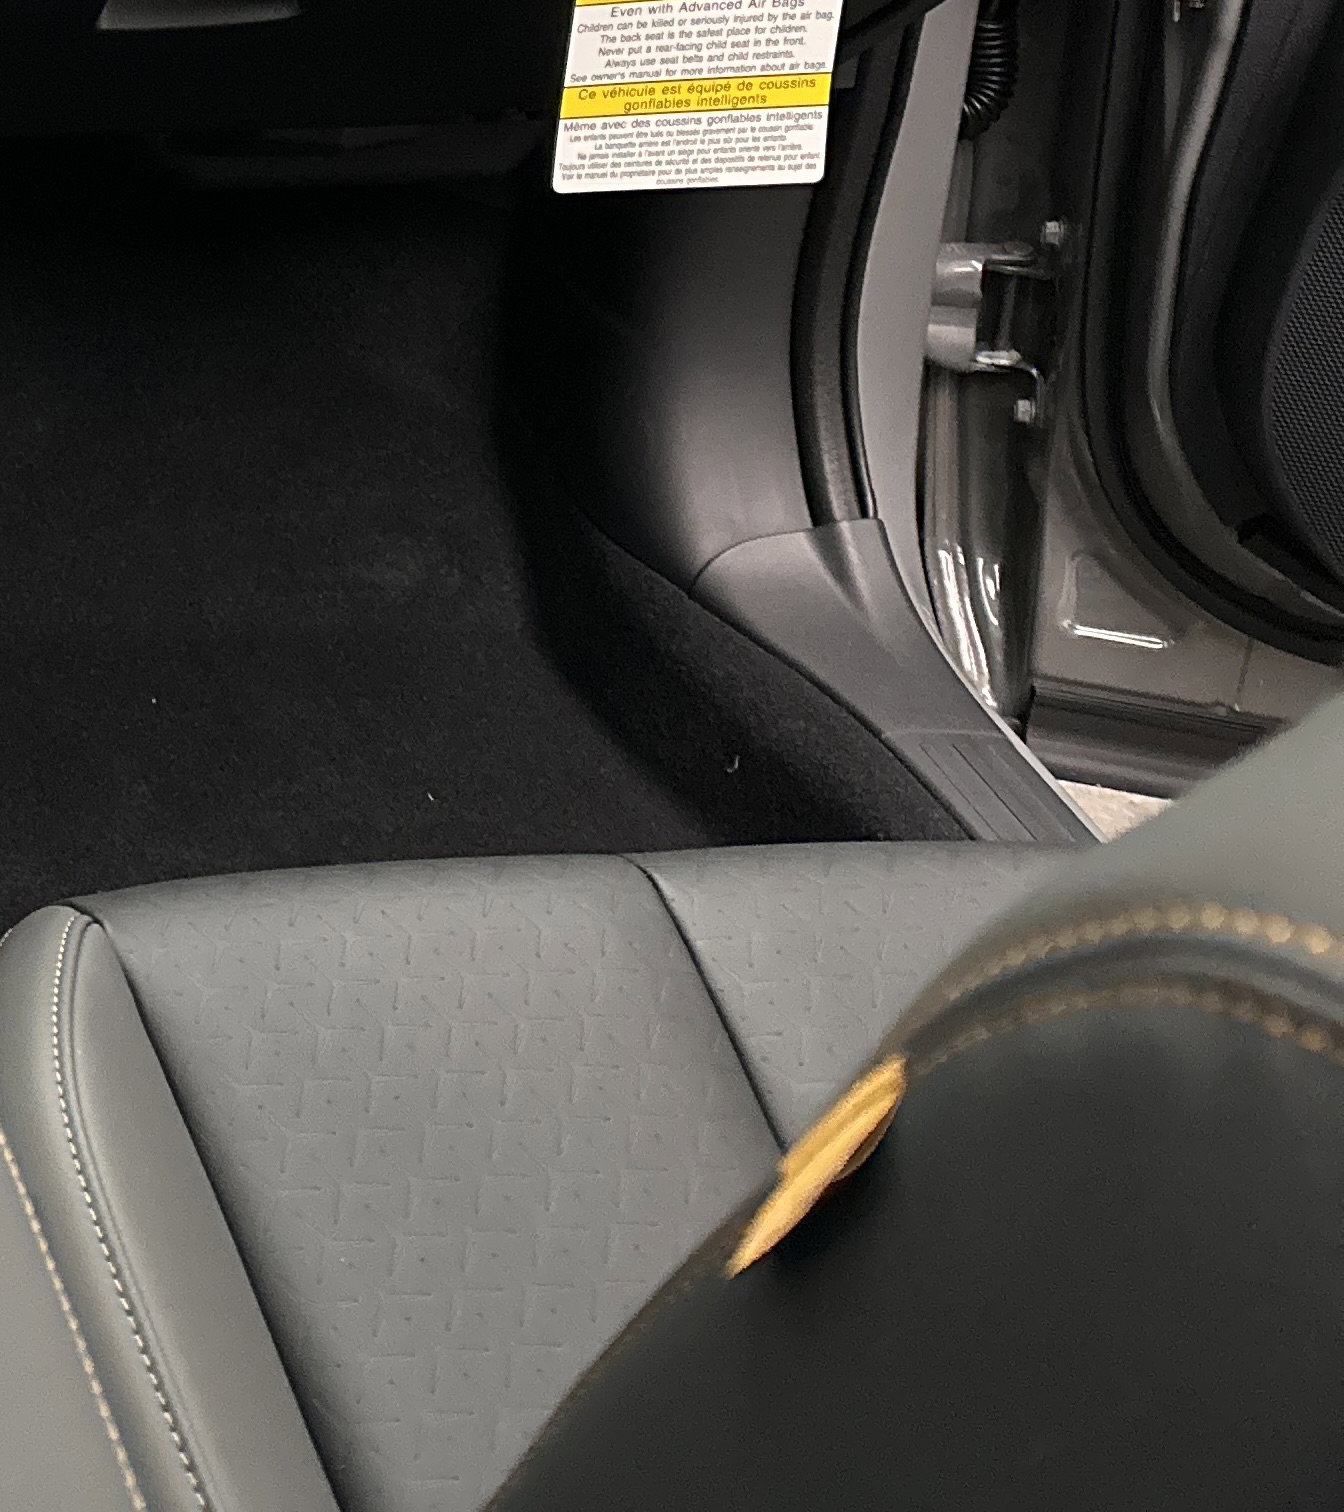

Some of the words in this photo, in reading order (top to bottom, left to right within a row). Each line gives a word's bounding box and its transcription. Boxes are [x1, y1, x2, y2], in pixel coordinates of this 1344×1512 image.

[610, 7, 642, 17] Even
[648, 4, 673, 15] with
[679, 0, 742, 14] Advanced
[748, 0, 765, 10] Air
[578, 89, 596, 100] Ce
[602, 86, 656, 99] véhicule
[661, 84, 681, 96] est
[687, 82, 731, 97] équipé
[736, 81, 753, 92] de
[759, 78, 816, 91] coussins
[623, 98, 691, 114] gonflables
[696, 94, 767, 108] intelligents
[563, 122, 597, 132] Même
[601, 122, 627, 130] avec
[631, 119, 651, 129] des
[655, 117, 702, 127] coussins
[707, 114, 761, 127] gonflables
[766, 111, 822, 123] intelligents
